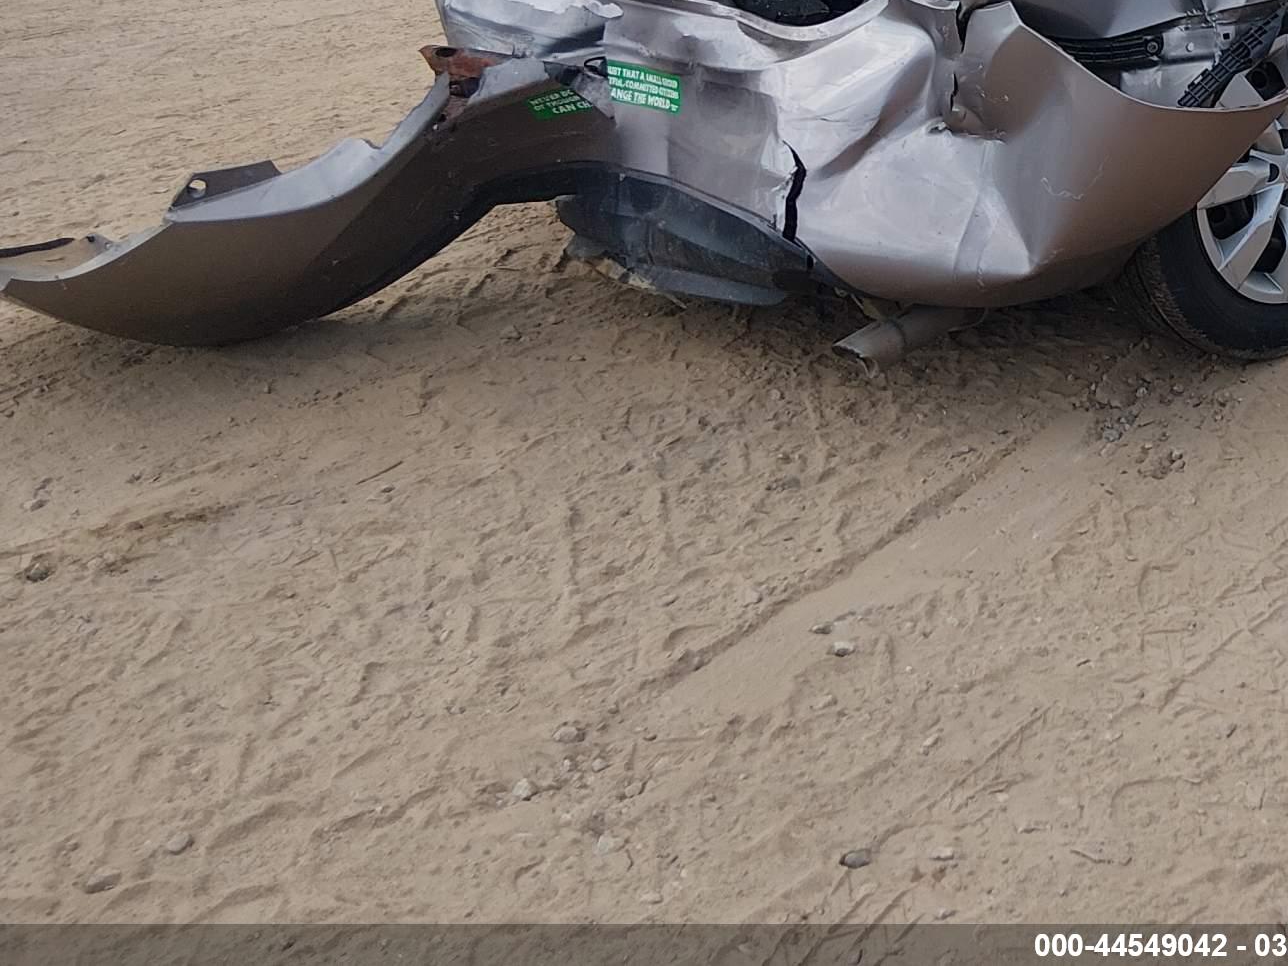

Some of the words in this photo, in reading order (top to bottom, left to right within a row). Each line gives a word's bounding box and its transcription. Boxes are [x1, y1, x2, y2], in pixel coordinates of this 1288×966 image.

[622, 68, 640, 79] THAT
[640, 72, 645, 81] A
[633, 92, 647, 104] THE
[647, 95, 670, 109] WORLD
[552, 103, 577, 114] CAN
